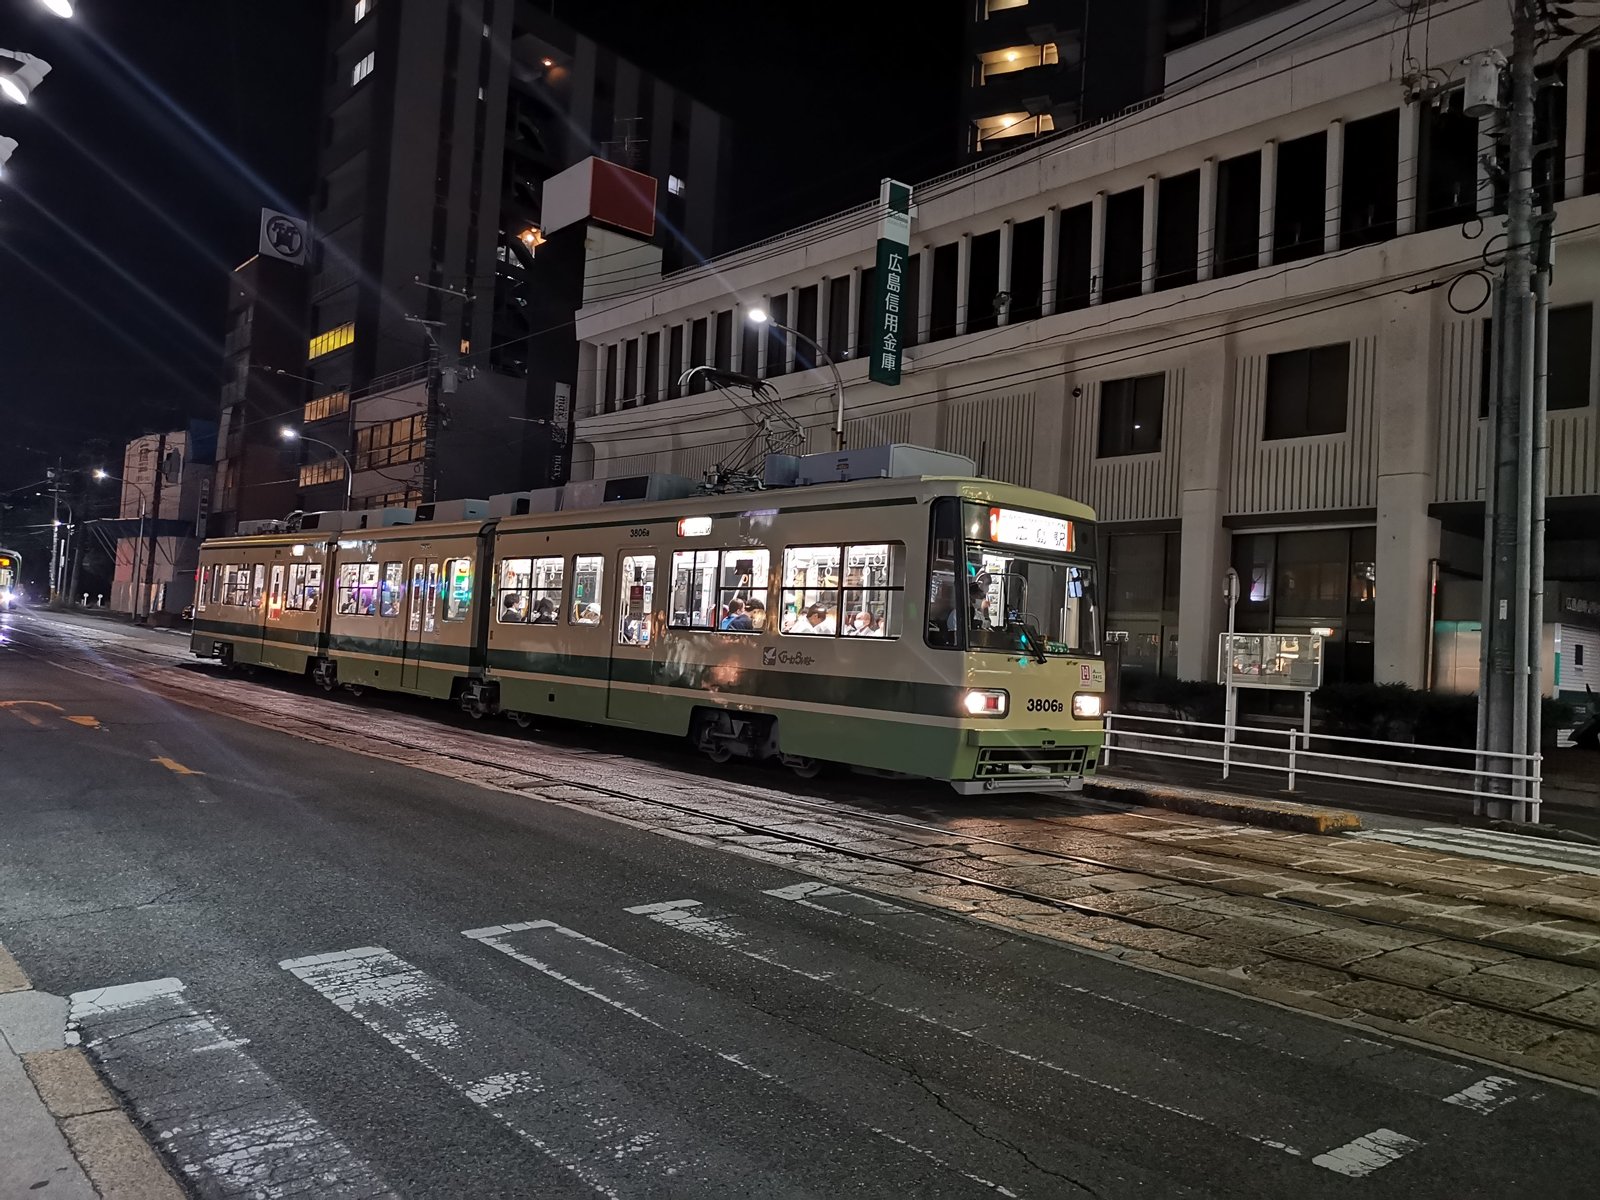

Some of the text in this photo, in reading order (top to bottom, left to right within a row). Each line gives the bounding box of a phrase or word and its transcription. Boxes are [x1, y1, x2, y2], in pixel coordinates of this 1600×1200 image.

[881, 253, 903, 372] 広島信用金庫
[1026, 698, 1063, 712] 3806B
